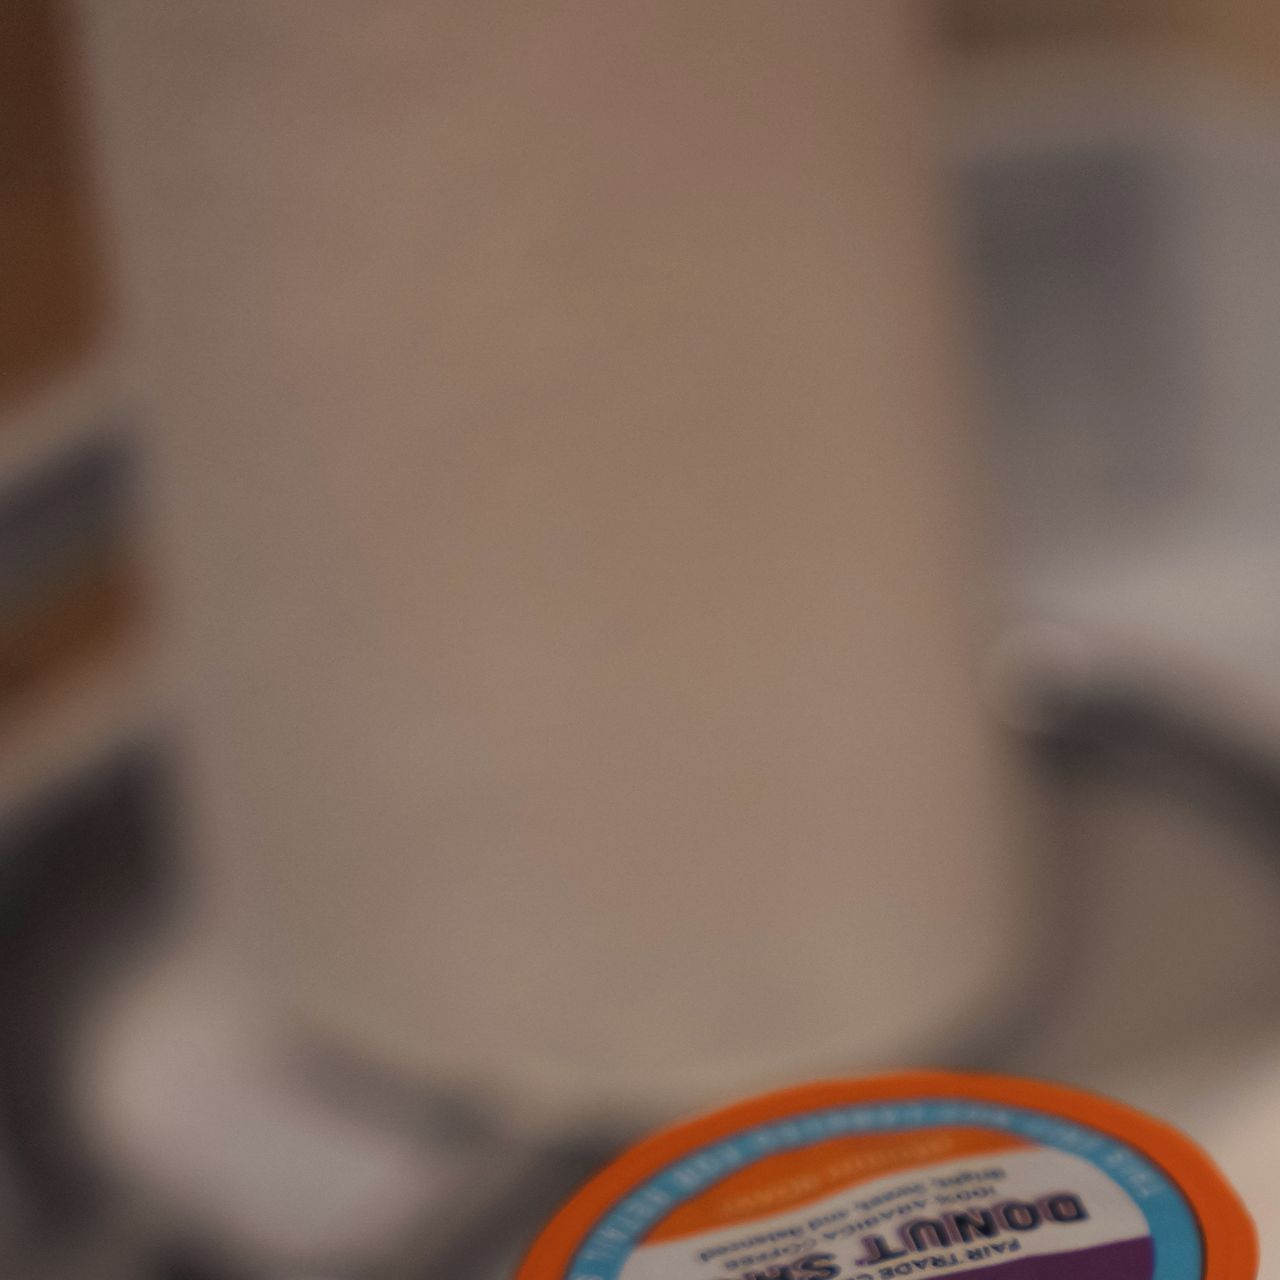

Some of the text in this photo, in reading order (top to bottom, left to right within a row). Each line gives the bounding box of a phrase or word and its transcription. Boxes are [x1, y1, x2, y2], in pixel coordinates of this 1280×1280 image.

[855, 1192, 1090, 1267] DONUT
[967, 1238, 1022, 1262] FAIR
[880, 1252, 962, 1280] TRADE
